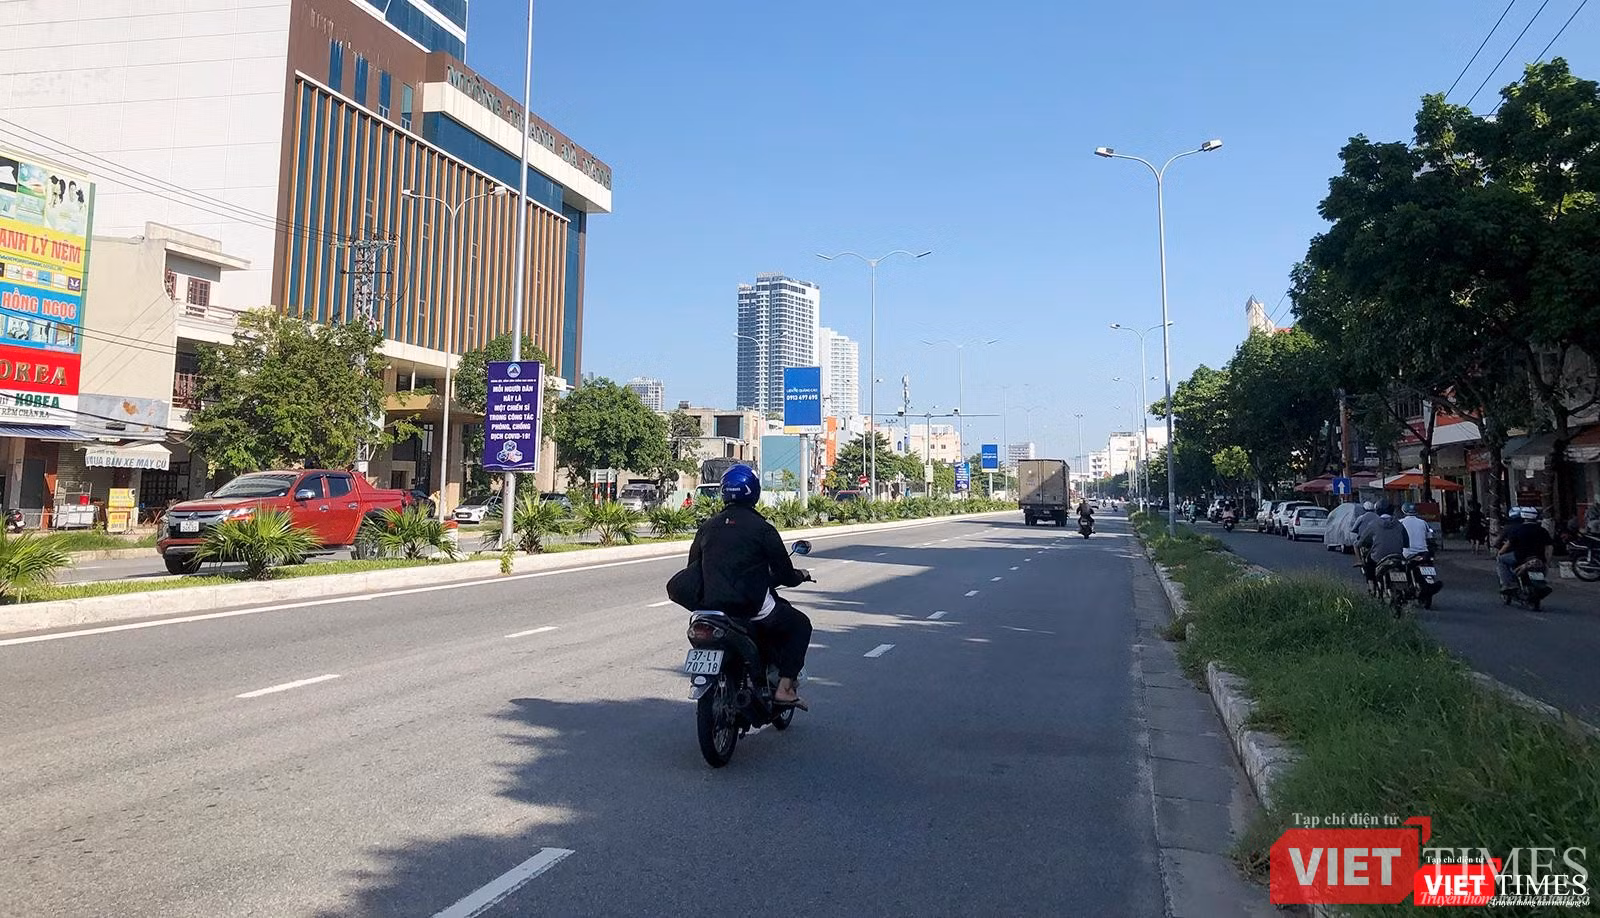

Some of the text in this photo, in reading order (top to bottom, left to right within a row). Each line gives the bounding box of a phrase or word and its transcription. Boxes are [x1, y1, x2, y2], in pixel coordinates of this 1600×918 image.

[31, 234, 48, 257] LÝ
[51, 239, 81, 265] NỆM
[42, 298, 77, 322] NGỌC
[123, 457, 134, 467] XE
[692, 651, 717, 661] 37-L1
[686, 661, 718, 673] 707.18
